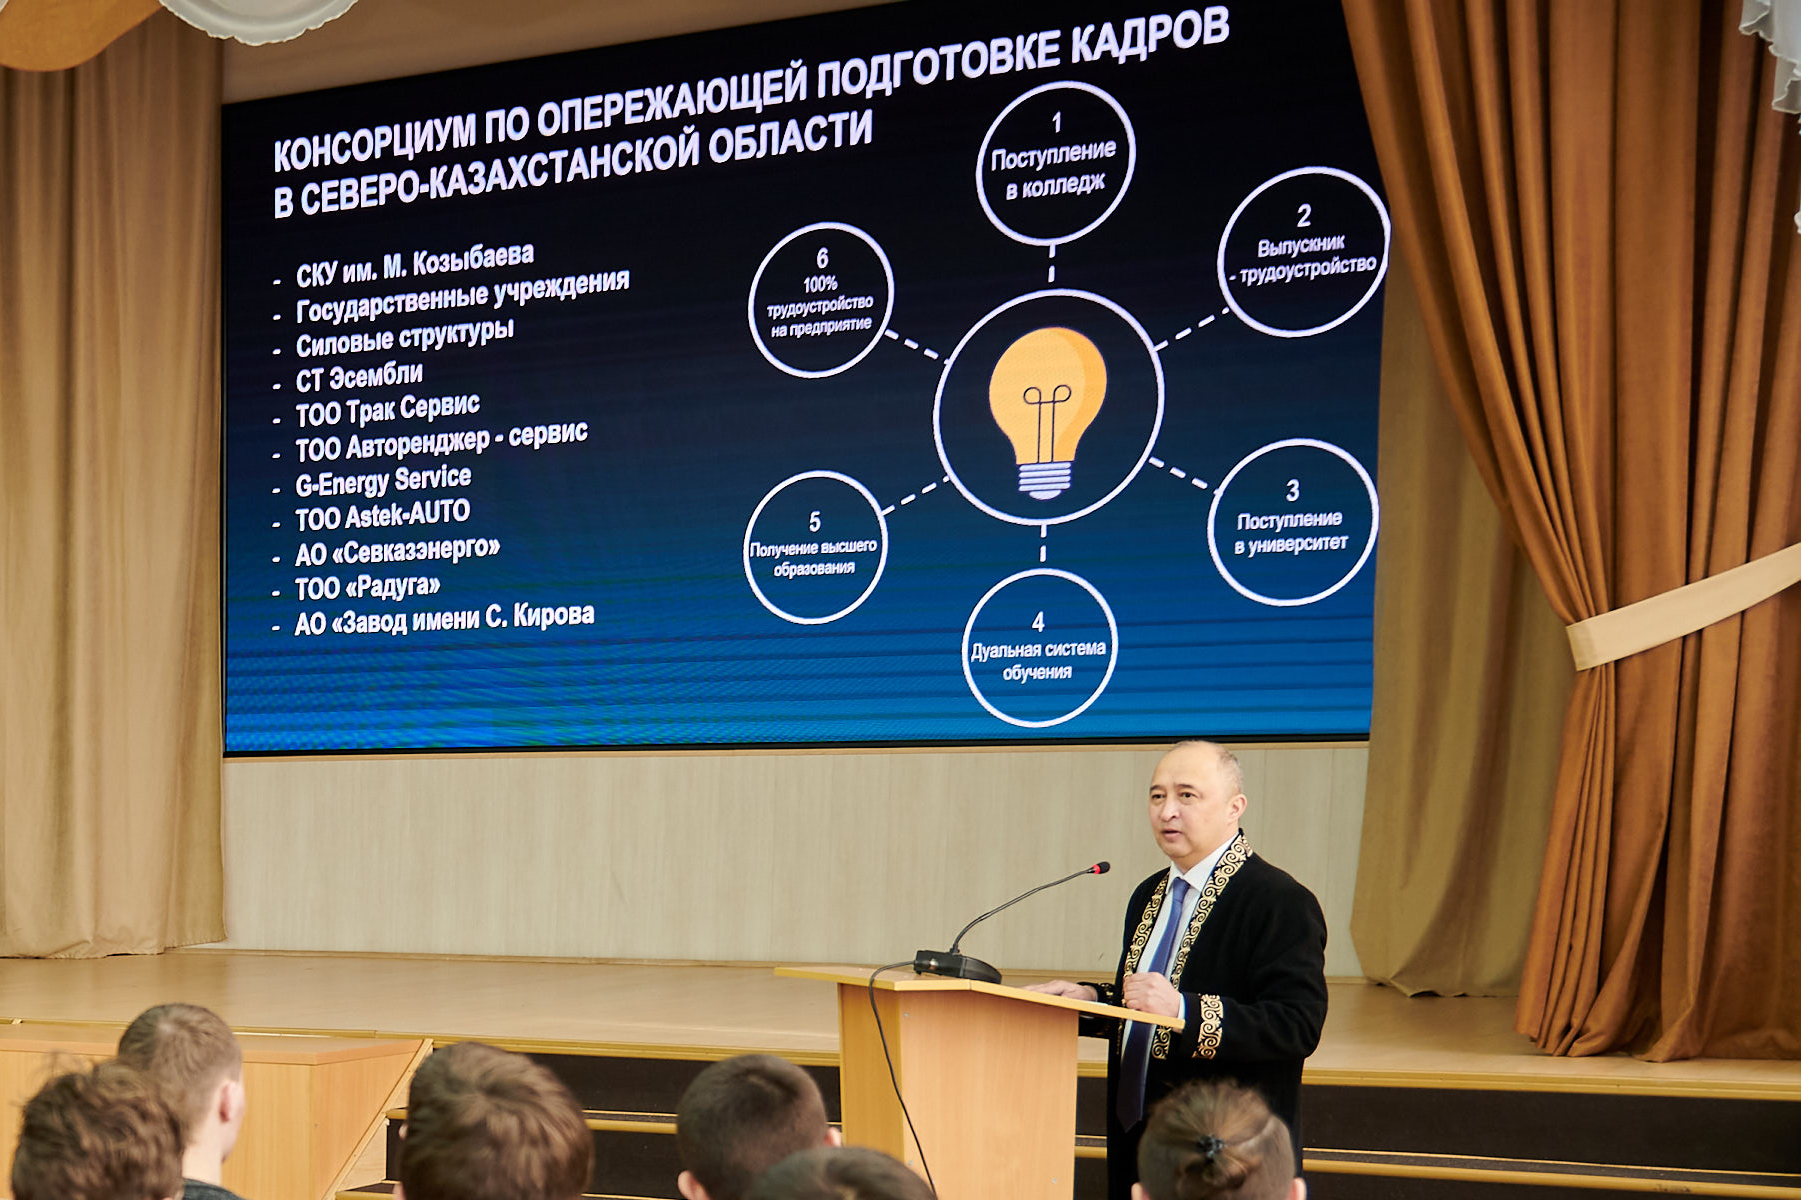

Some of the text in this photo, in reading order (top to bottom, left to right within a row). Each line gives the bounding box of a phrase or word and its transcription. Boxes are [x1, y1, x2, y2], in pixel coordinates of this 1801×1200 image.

[274, 5, 1230, 172] КОНСОРЦИУМ ПО ОПЕРЕЖАЮЩЕЙ ПОДГОТОВКЕ КАДРОВ
[1052, 111, 1061, 133] 1
[274, 109, 873, 219] В СЕВЕРО-КАЗАХСТАНСКОЙ ОБЛАСТИ
[991, 140, 1117, 172] Поступление
[1006, 173, 1106, 201] в колледж
[1297, 203, 1312, 228] 2
[816, 247, 829, 269] 6
[1257, 235, 1345, 258] Выпускник
[296, 243, 534, 288] СКУ им. М. Козыбаева
[1239, 256, 1377, 286] трудоустройство
[296, 270, 630, 323] Государственные учреждения
[803, 275, 838, 293] 100%
[766, 295, 874, 320] трудоустройство
[296, 319, 514, 358] Силовые структуры
[771, 317, 872, 339] на предприятие
[296, 360, 423, 393] СТ Эсембли
[295, 394, 481, 429] ТОО Трак Сервис
[295, 436, 342, 463] ТОО
[345, 430, 491, 461] Авторенджер
[508, 422, 588, 450] сервис
[295, 463, 472, 499] G-Energy Service
[1286, 479, 1300, 502] 3
[294, 498, 471, 532] ТОО Astek-AUTO
[809, 511, 821, 533] 5
[1237, 512, 1343, 533] Поступление
[294, 538, 501, 569] АО «Севказэнерго»
[749, 540, 878, 560] Получение высшего
[1234, 535, 1349, 558] в университет
[773, 561, 856, 580] образования
[294, 574, 441, 602] ТОО «Радуга»
[294, 602, 595, 636] АО «Завод имени С. Кирова
[1031, 611, 1045, 633] 4
[970, 641, 1107, 663] Дуальная система
[1002, 664, 1073, 685] обучения
